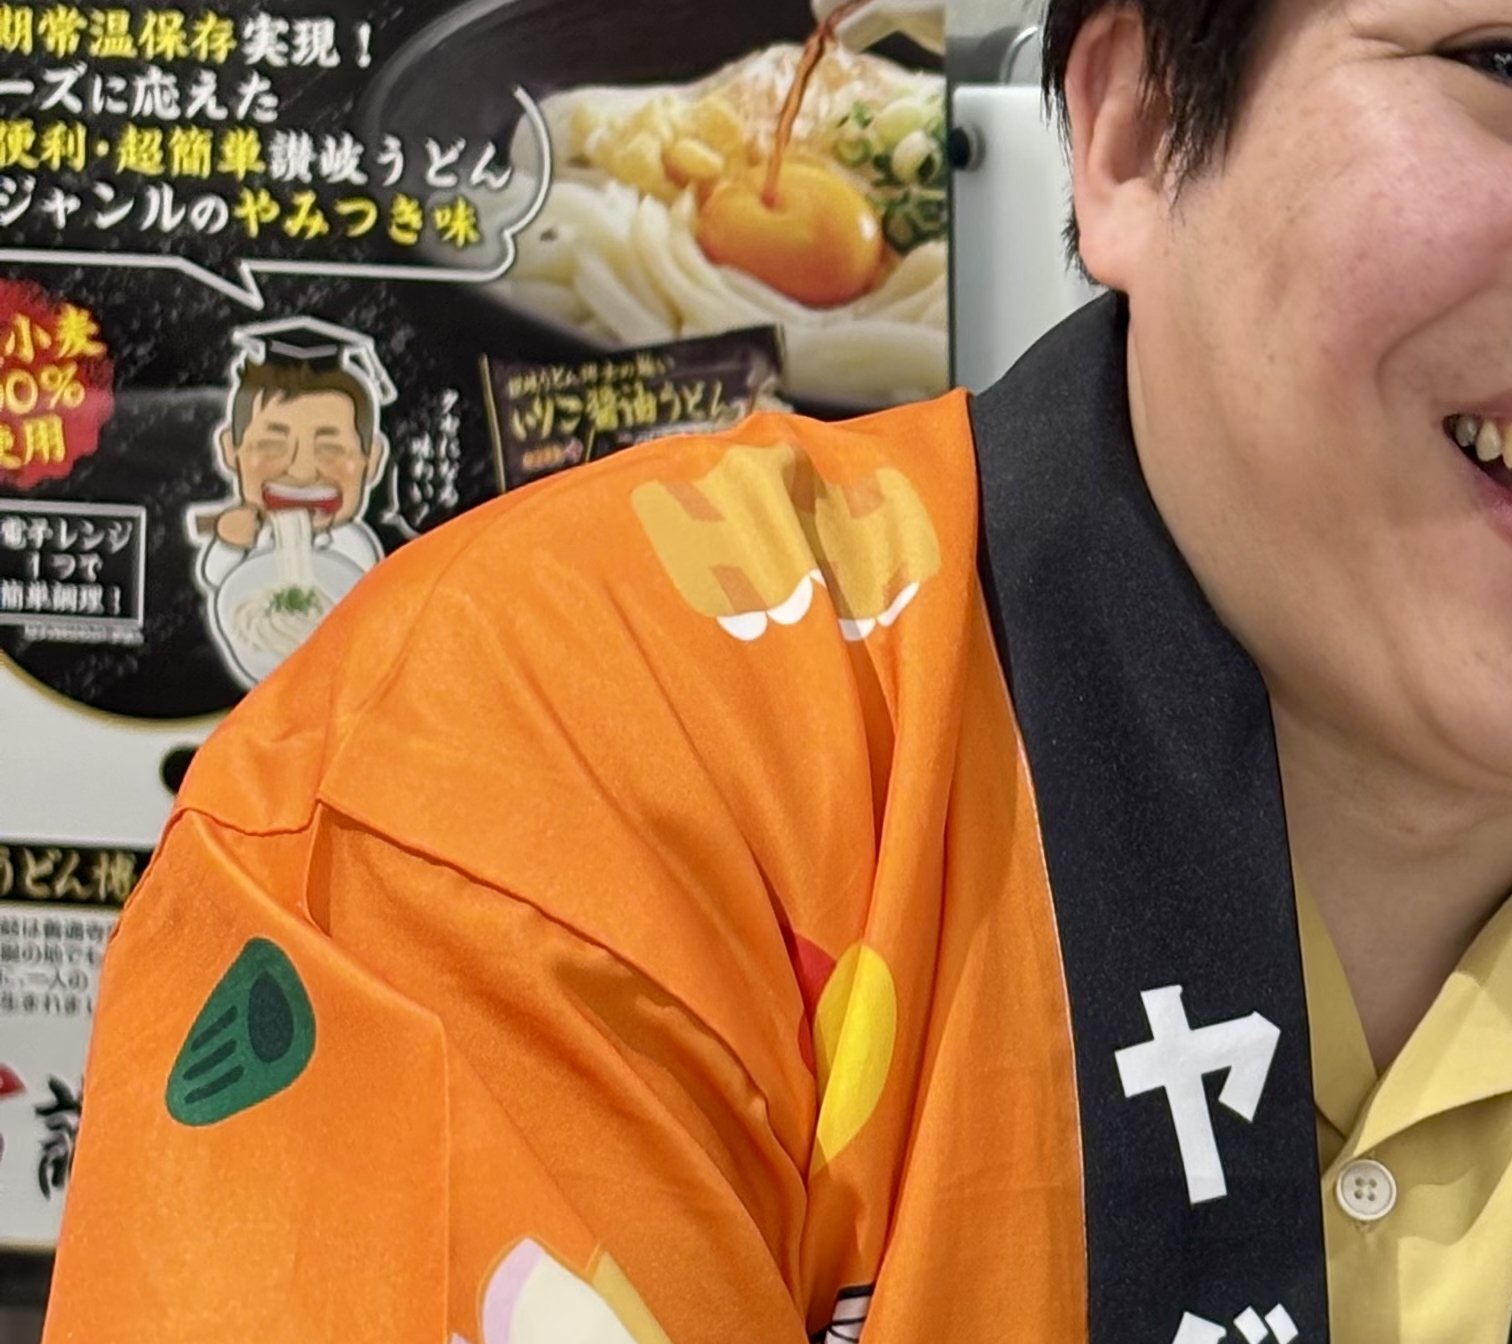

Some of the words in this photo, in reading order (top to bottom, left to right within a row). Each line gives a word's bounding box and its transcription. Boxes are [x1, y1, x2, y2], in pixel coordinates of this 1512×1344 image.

[0, 174, 482, 248] ジャンルのやみつき味
[0, 359, 86, 416] 0%
